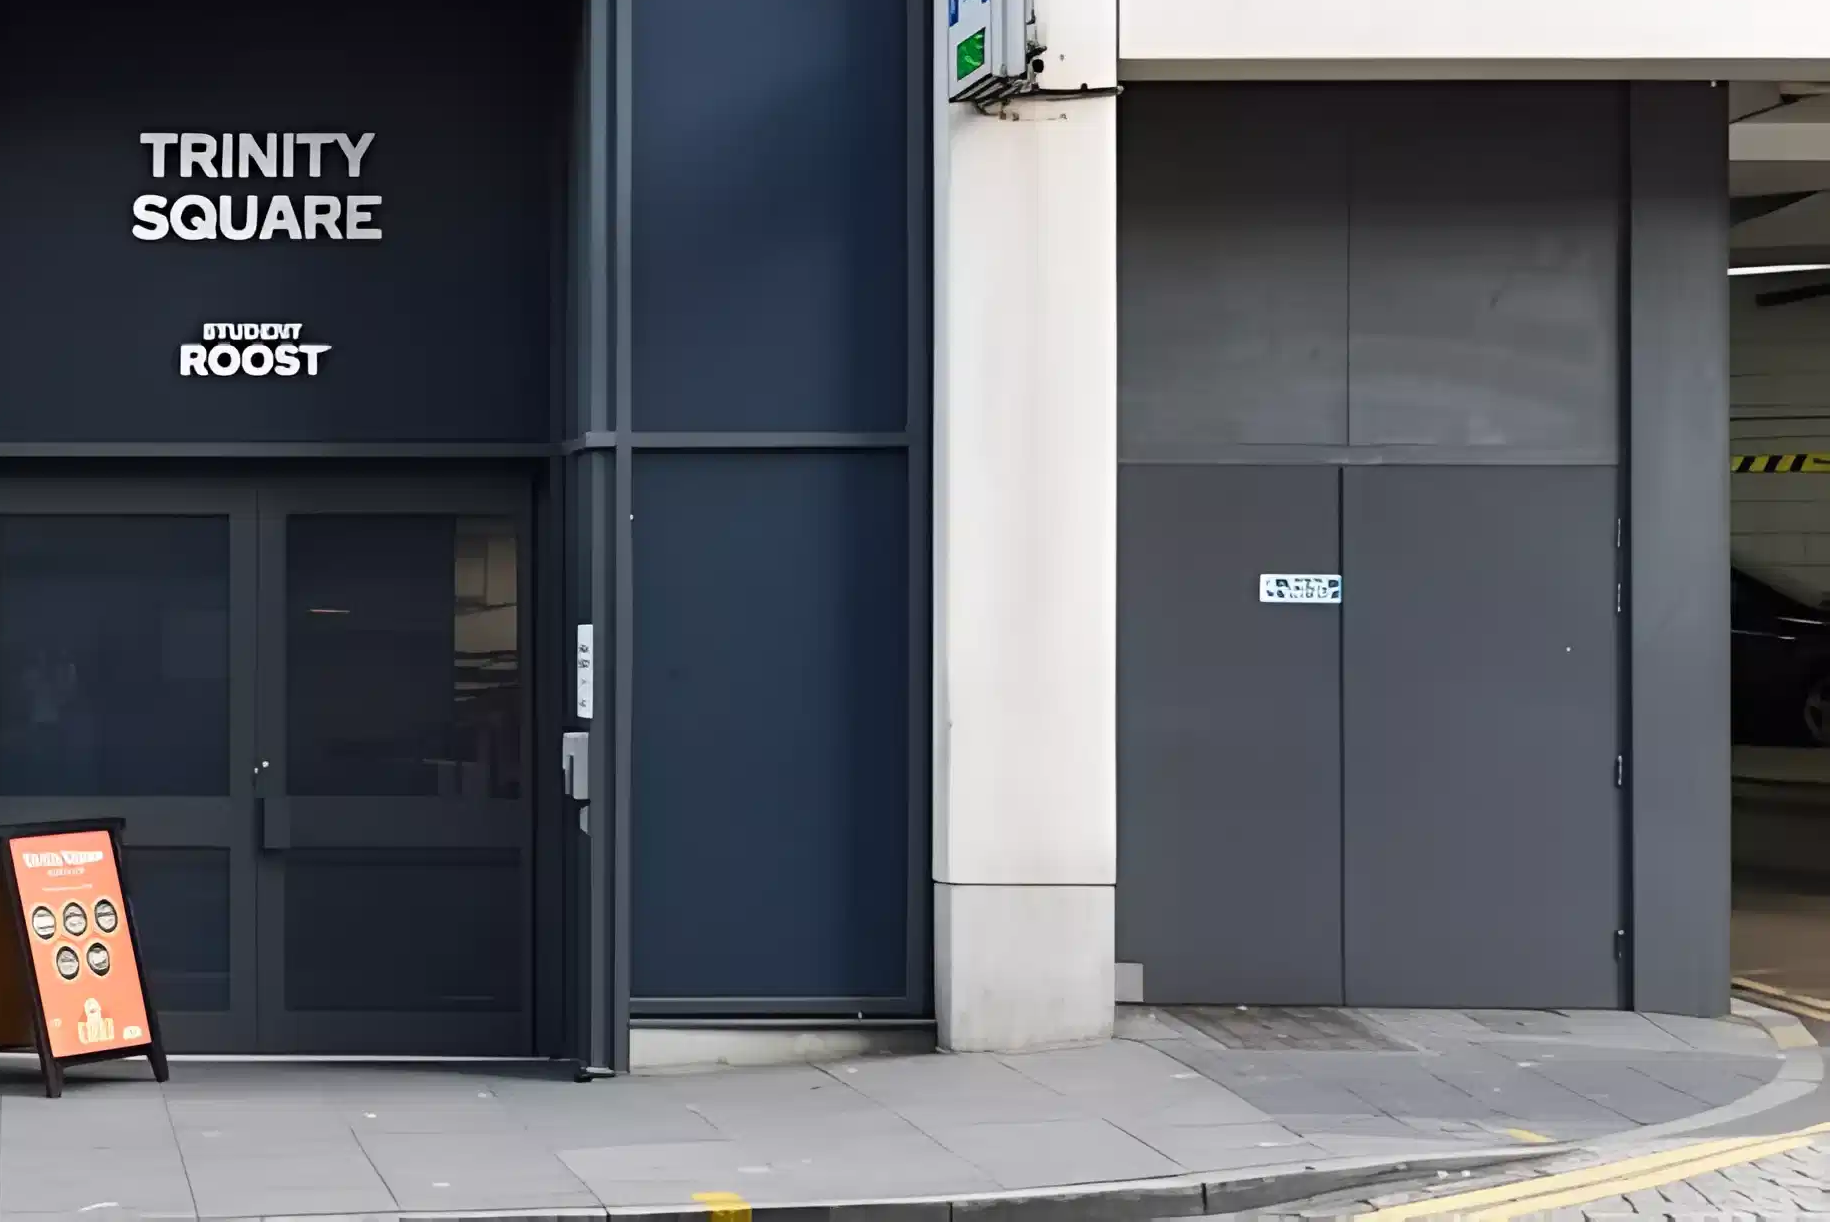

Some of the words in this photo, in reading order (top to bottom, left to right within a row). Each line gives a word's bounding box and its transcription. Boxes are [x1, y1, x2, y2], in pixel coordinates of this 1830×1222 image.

[139, 132, 376, 179] TRINITY
[131, 194, 383, 241] SQUARE
[203, 322, 303, 341] STUDENT
[179, 343, 333, 377] ROOST
